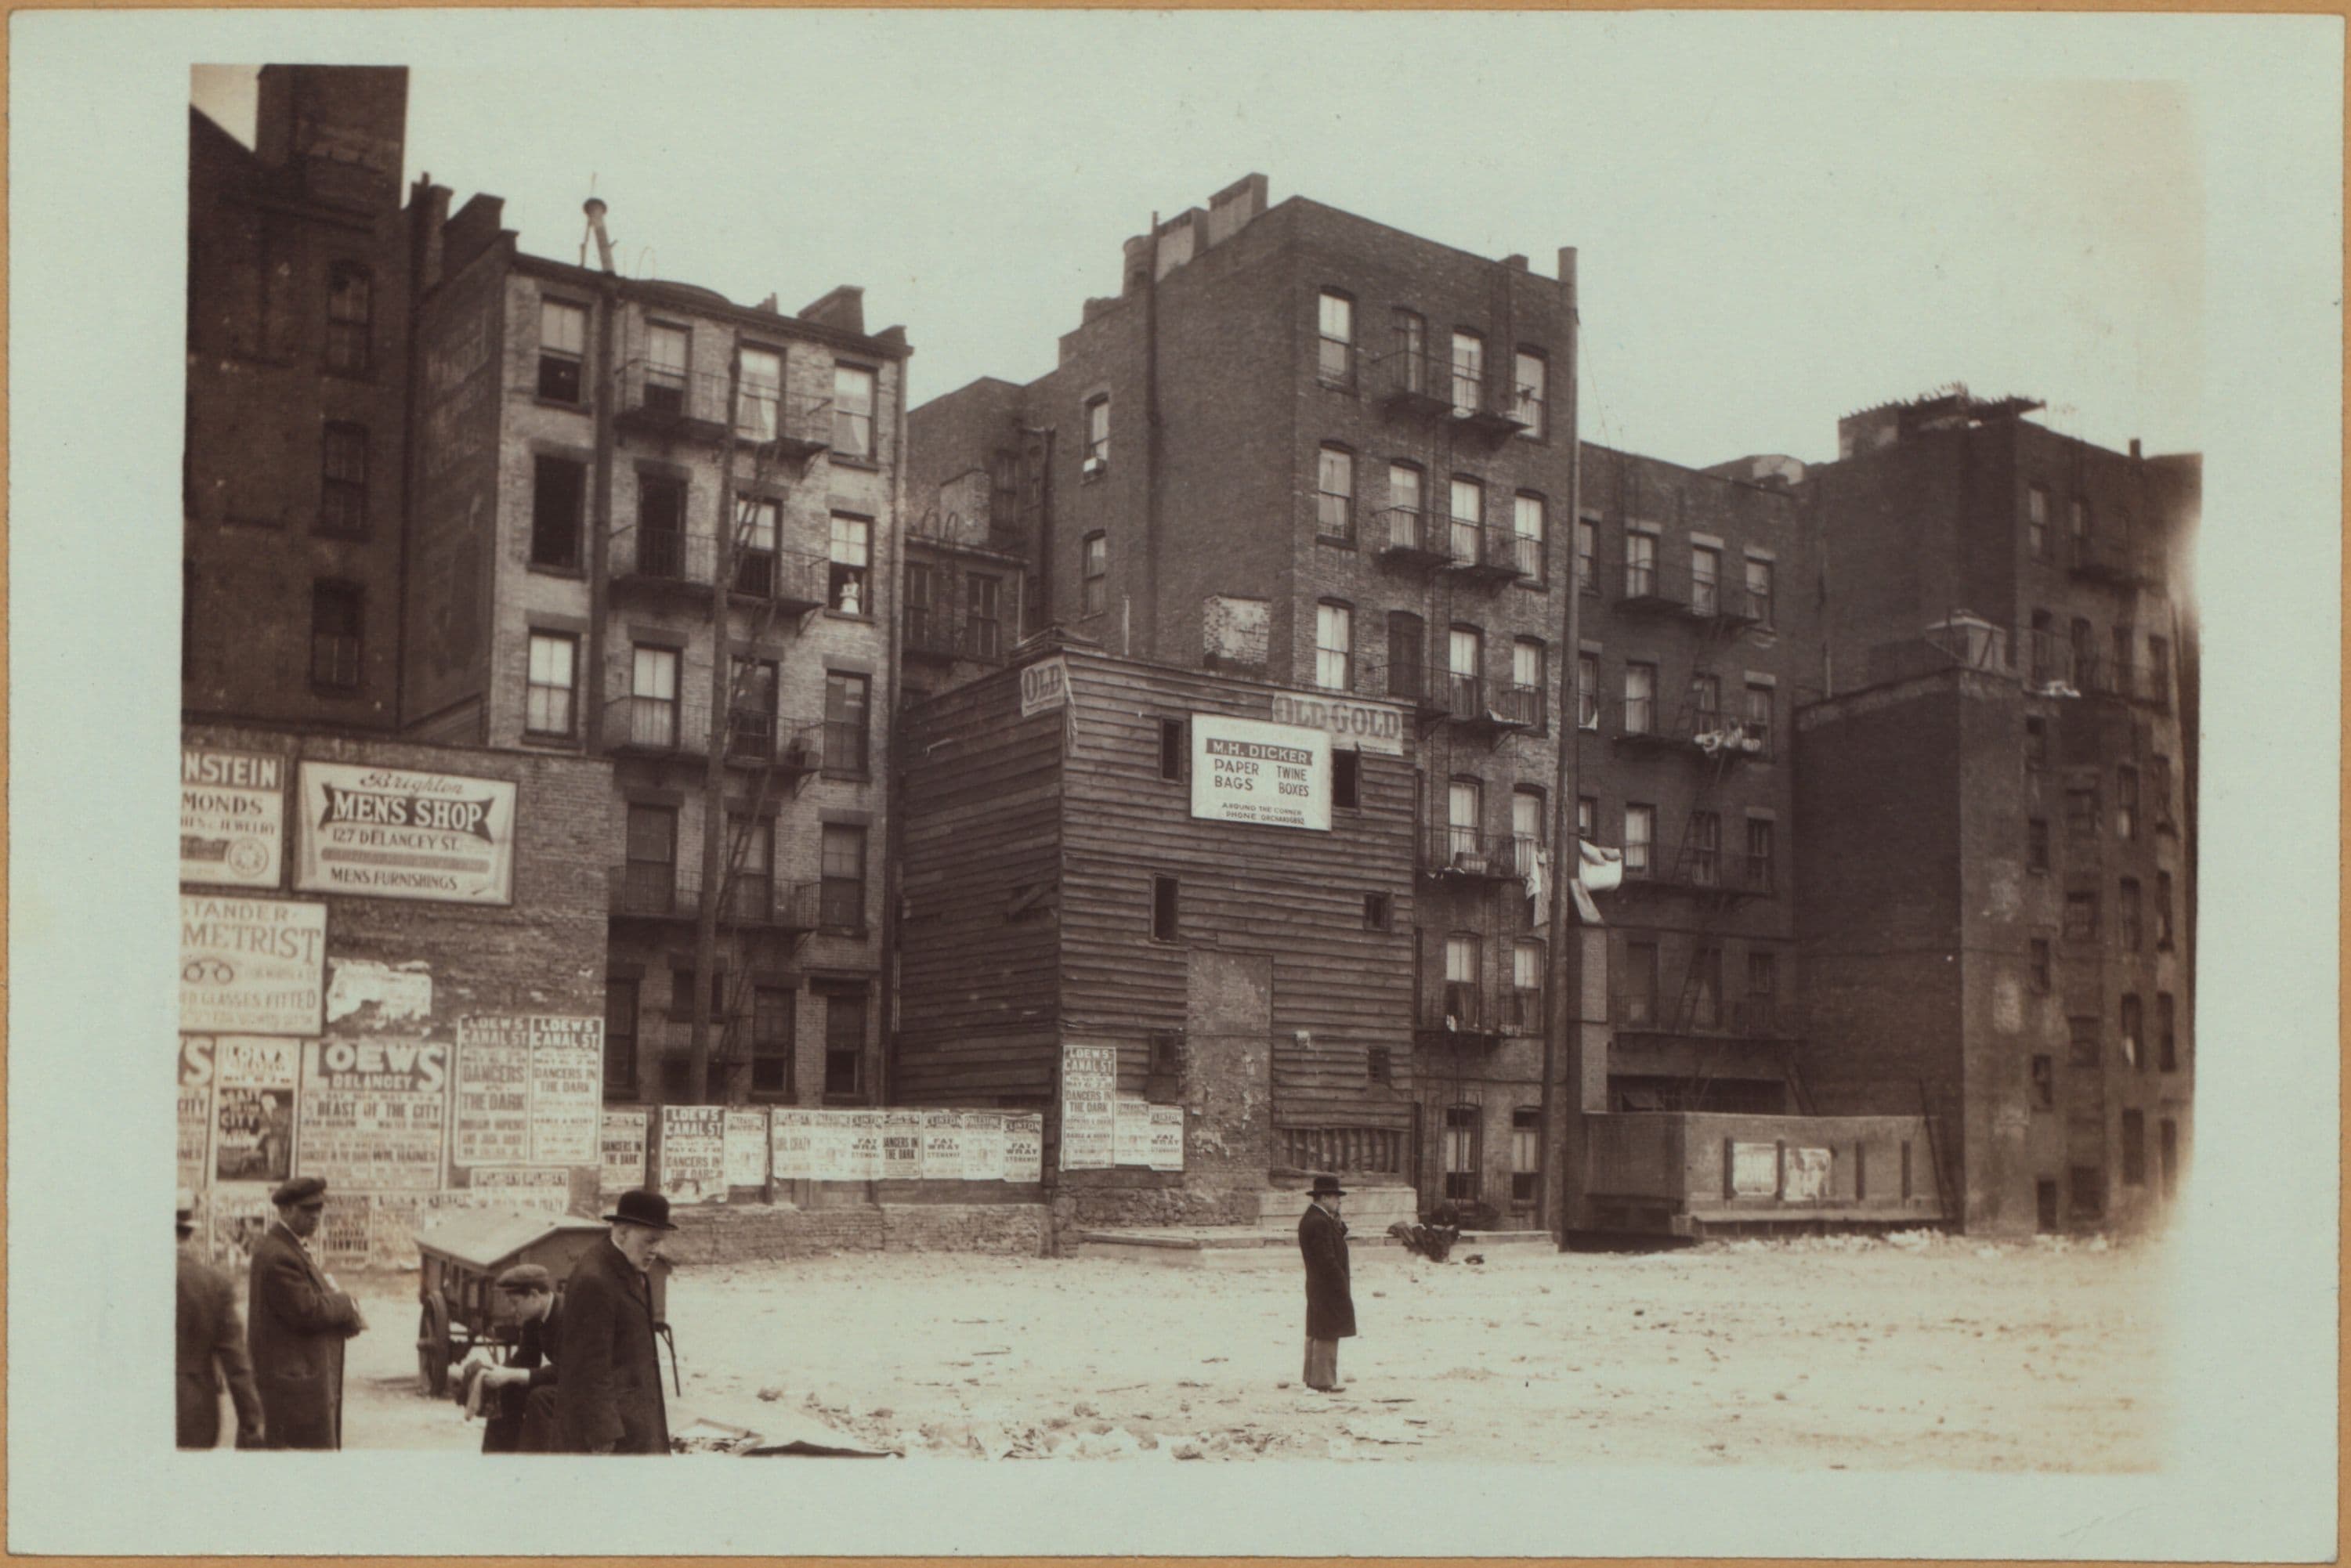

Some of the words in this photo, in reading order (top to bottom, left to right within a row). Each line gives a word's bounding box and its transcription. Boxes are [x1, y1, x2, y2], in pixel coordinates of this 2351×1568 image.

[1024, 664, 1060, 702] OLD
[1273, 695, 1327, 729] OLD
[1330, 703, 1401, 739] GOLD
[1250, 745, 1308, 764] DICKER
[183, 750, 277, 788] NSTEIN
[1214, 758, 1260, 775] PAPER
[1276, 765, 1308, 782] TWINE
[360, 771, 464, 795] Brighton
[1214, 775, 1253, 791] BAGS
[1279, 782, 1309, 797] BOXES
[331, 790, 407, 825] MENS
[414, 797, 483, 832] SHOP
[1221, 801, 1257, 811] AROUND
[1274, 806, 1302, 815] CORNER
[1225, 811, 1257, 820] PHONE
[332, 827, 356, 844] 127
[359, 828, 437, 850] DELANCEY
[331, 866, 371, 885] MENS
[374, 870, 458, 891] FURNISHINGS
[181, 921, 321, 966] METRIST
[462, 1030, 508, 1044] CANAL
[533, 1031, 579, 1047] CANAL
[581, 1033, 599, 1048] ST
[1064, 1059, 1100, 1072] CANAL
[331, 1074, 413, 1090] DELANCEY
[412, 1103, 439, 1118] CITY
[666, 1122, 703, 1136] CANAL
